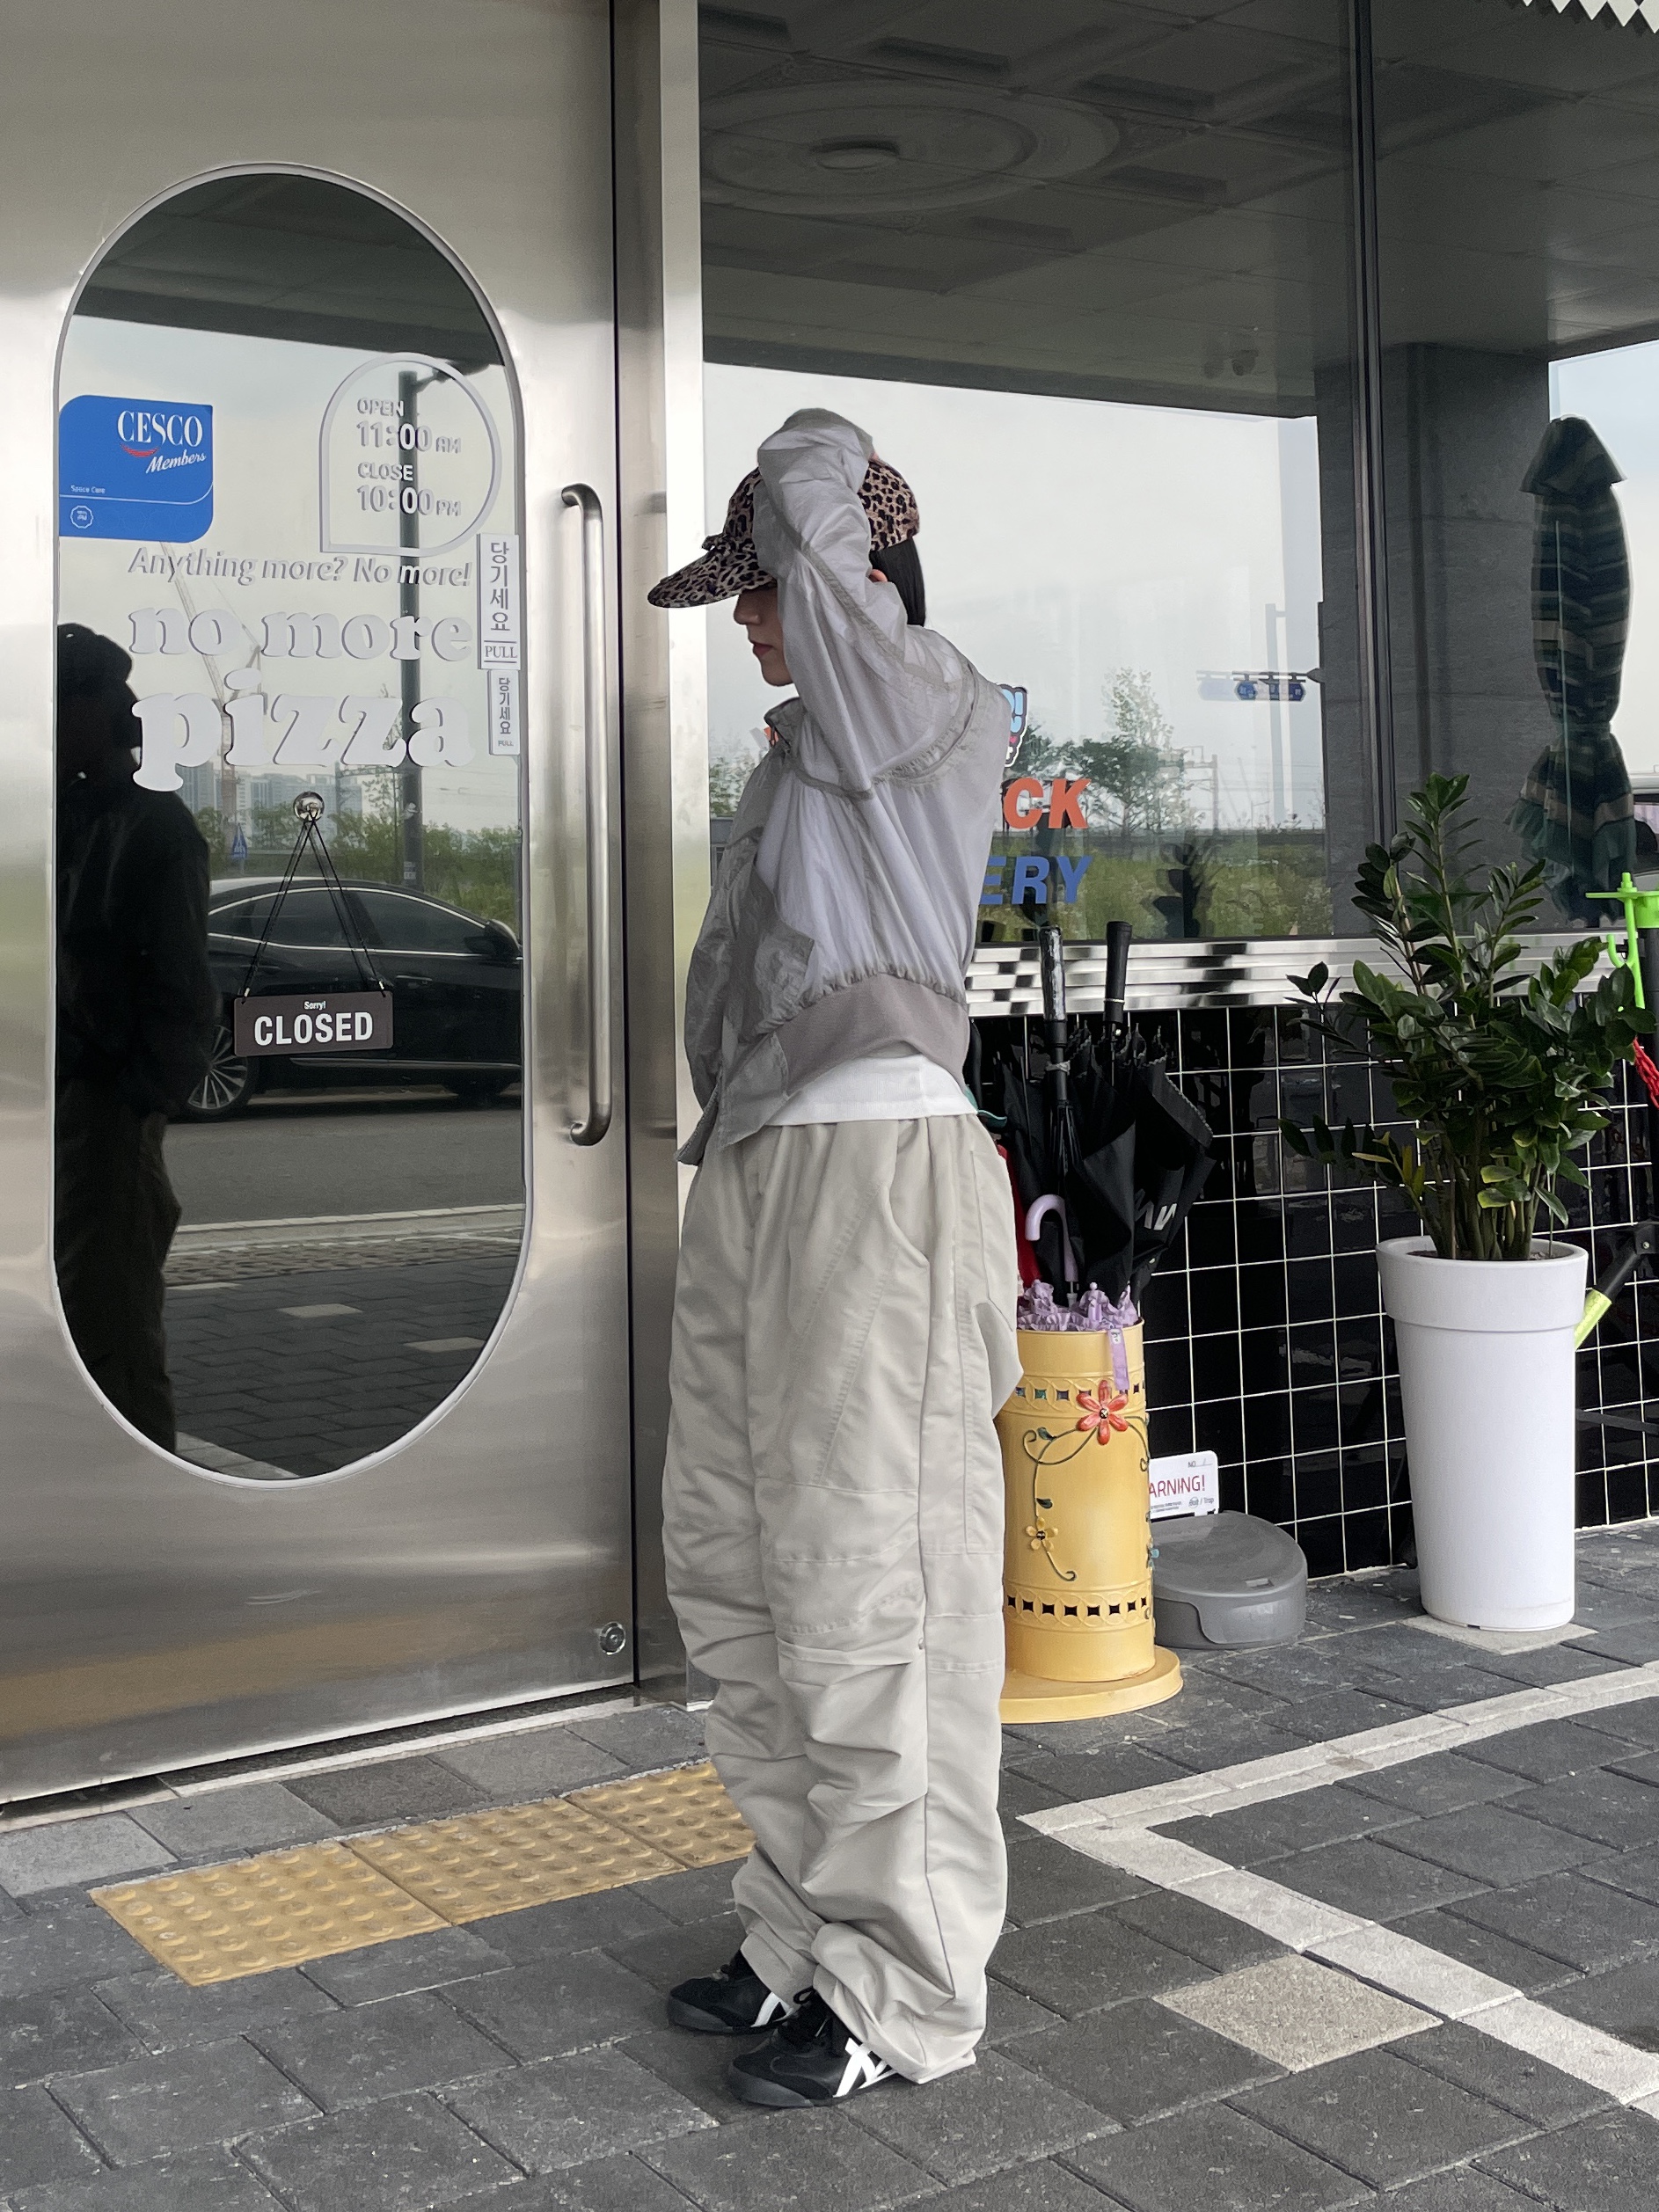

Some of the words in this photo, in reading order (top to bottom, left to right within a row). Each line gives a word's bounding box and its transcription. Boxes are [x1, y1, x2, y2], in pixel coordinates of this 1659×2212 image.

[356, 397, 405, 417] OPEN
[117, 410, 203, 447] CESCO
[356, 420, 433, 452] 11:00
[435, 436, 462, 453] AM
[145, 449, 207, 474] Members
[357, 462, 413, 481] CLOSE
[356, 485, 435, 515] 10:00
[435, 499, 462, 516] PM
[128, 547, 259, 586] Anything
[261, 556, 350, 582] more?
[353, 557, 391, 584] No
[398, 561, 473, 587] more!
[490, 541, 511, 631] 당기세요
[128, 607, 242, 656] no
[261, 610, 474, 661] more
[485, 645, 518, 659] PULL
[498, 677, 511, 734] 당기세요
[132, 667, 475, 792] pizza
[303, 1001, 326, 1011] Sorry!
[254, 1011, 374, 1046] CLOSED
